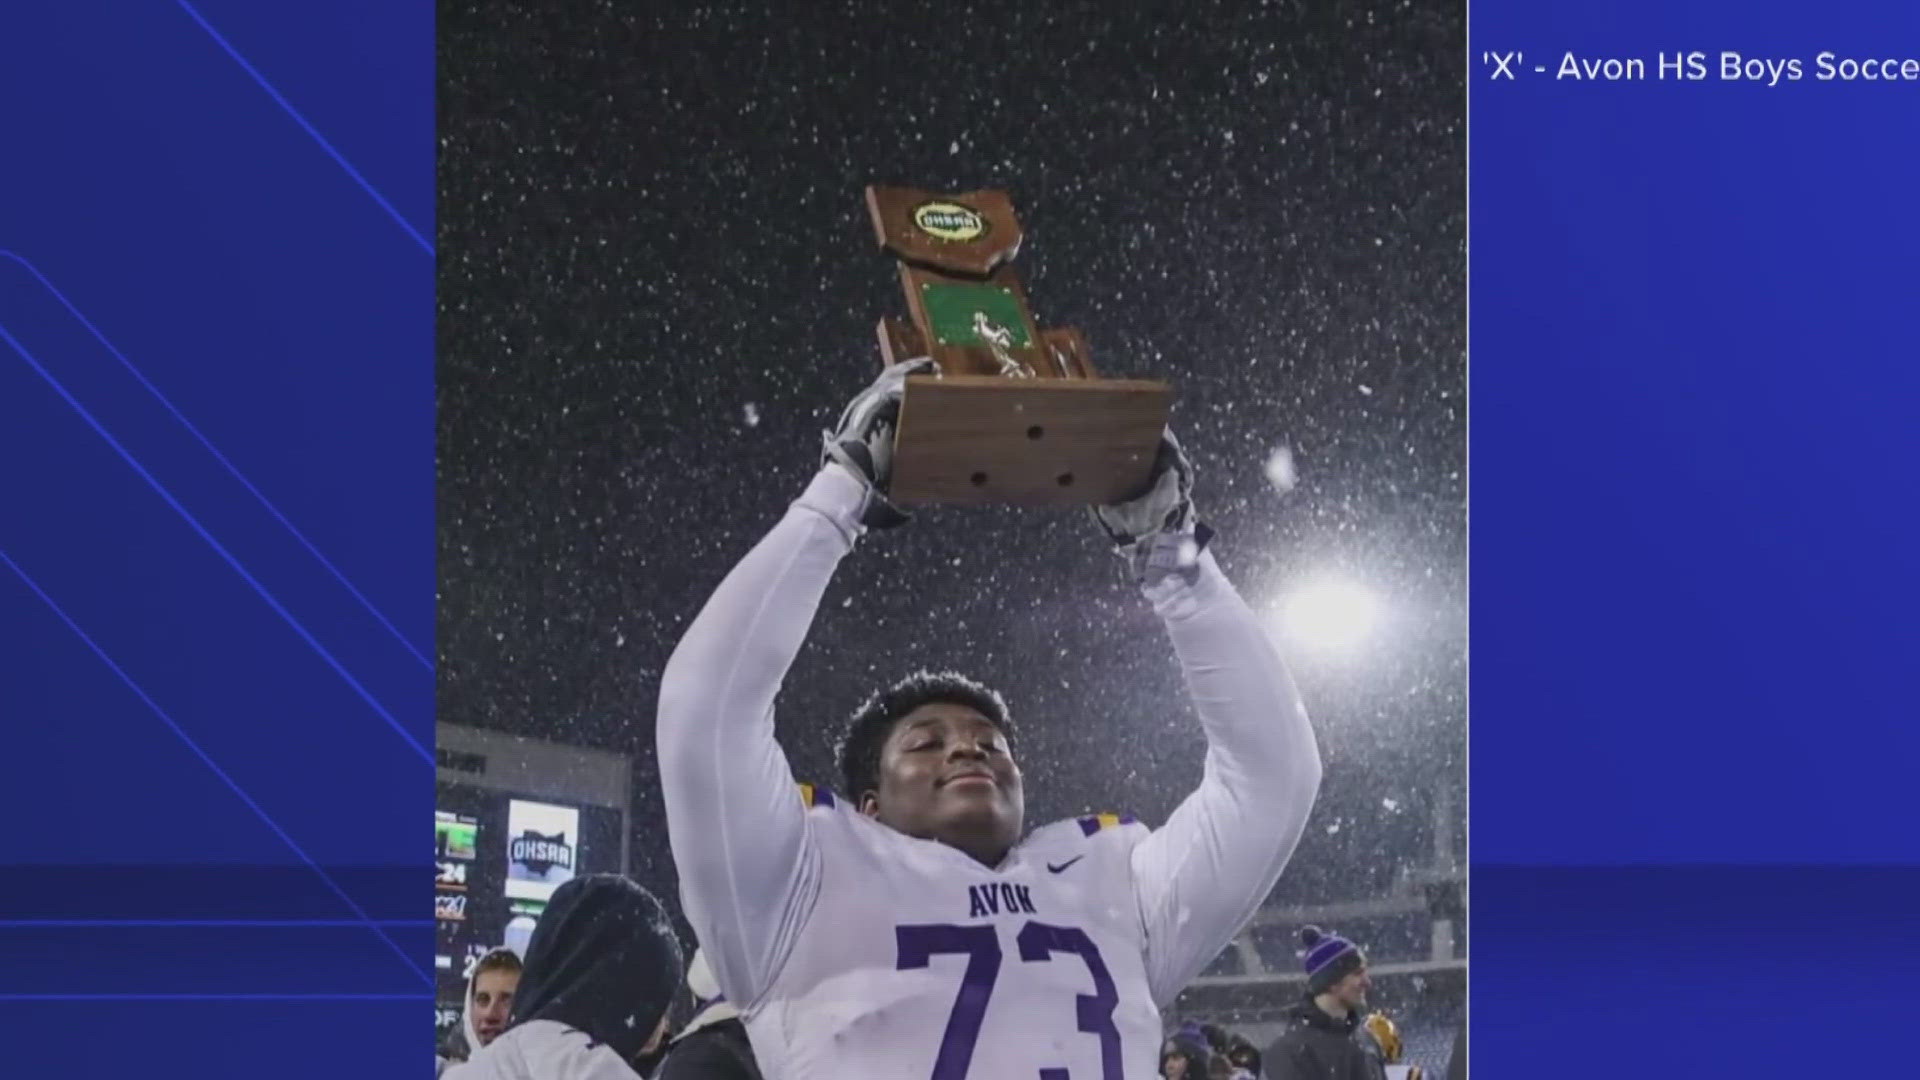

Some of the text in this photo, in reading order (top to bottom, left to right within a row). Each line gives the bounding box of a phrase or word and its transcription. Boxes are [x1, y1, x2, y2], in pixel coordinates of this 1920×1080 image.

[513, 840, 570, 866] OHSAA
[968, 881, 1037, 918] AVON
[895, 919, 1124, 1080] 73
